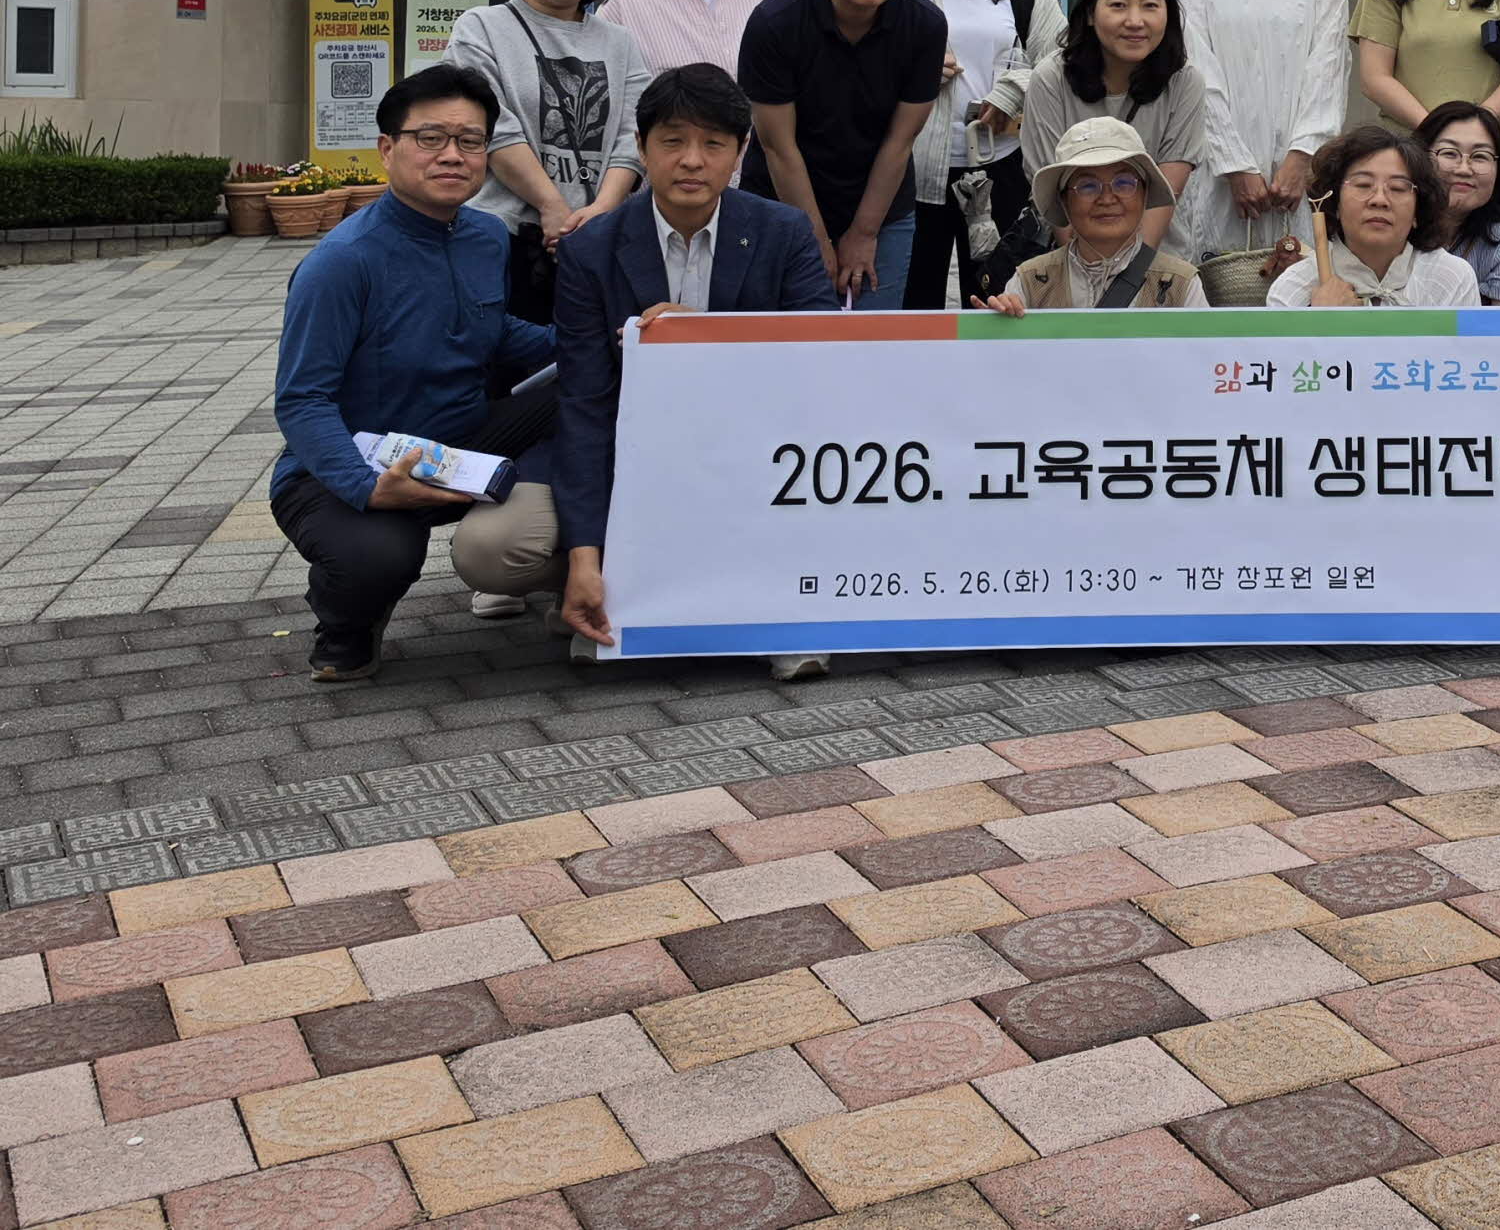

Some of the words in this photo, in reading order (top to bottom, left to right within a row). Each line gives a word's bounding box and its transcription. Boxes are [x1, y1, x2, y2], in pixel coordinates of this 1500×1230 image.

[313, 23, 358, 37] 사전결제
[359, 23, 390, 36] 서비스
[416, 25, 438, 33] 2026.
[1213, 360, 1278, 394] 앎과
[1291, 360, 1353, 393] 삶이
[1371, 359, 1500, 392] 조화로운
[770, 440, 943, 506] 2026.
[968, 434, 1284, 501] 교육공동체
[834, 572, 909, 598] 2026.
[922, 571, 945, 595] 5.
[959, 568, 1050, 595] 26.(화)
[1065, 568, 1137, 593] 13:30
[1176, 566, 1225, 591] 거창
[1237, 565, 1312, 590] 창포원
[1327, 566, 1376, 590] 일원
